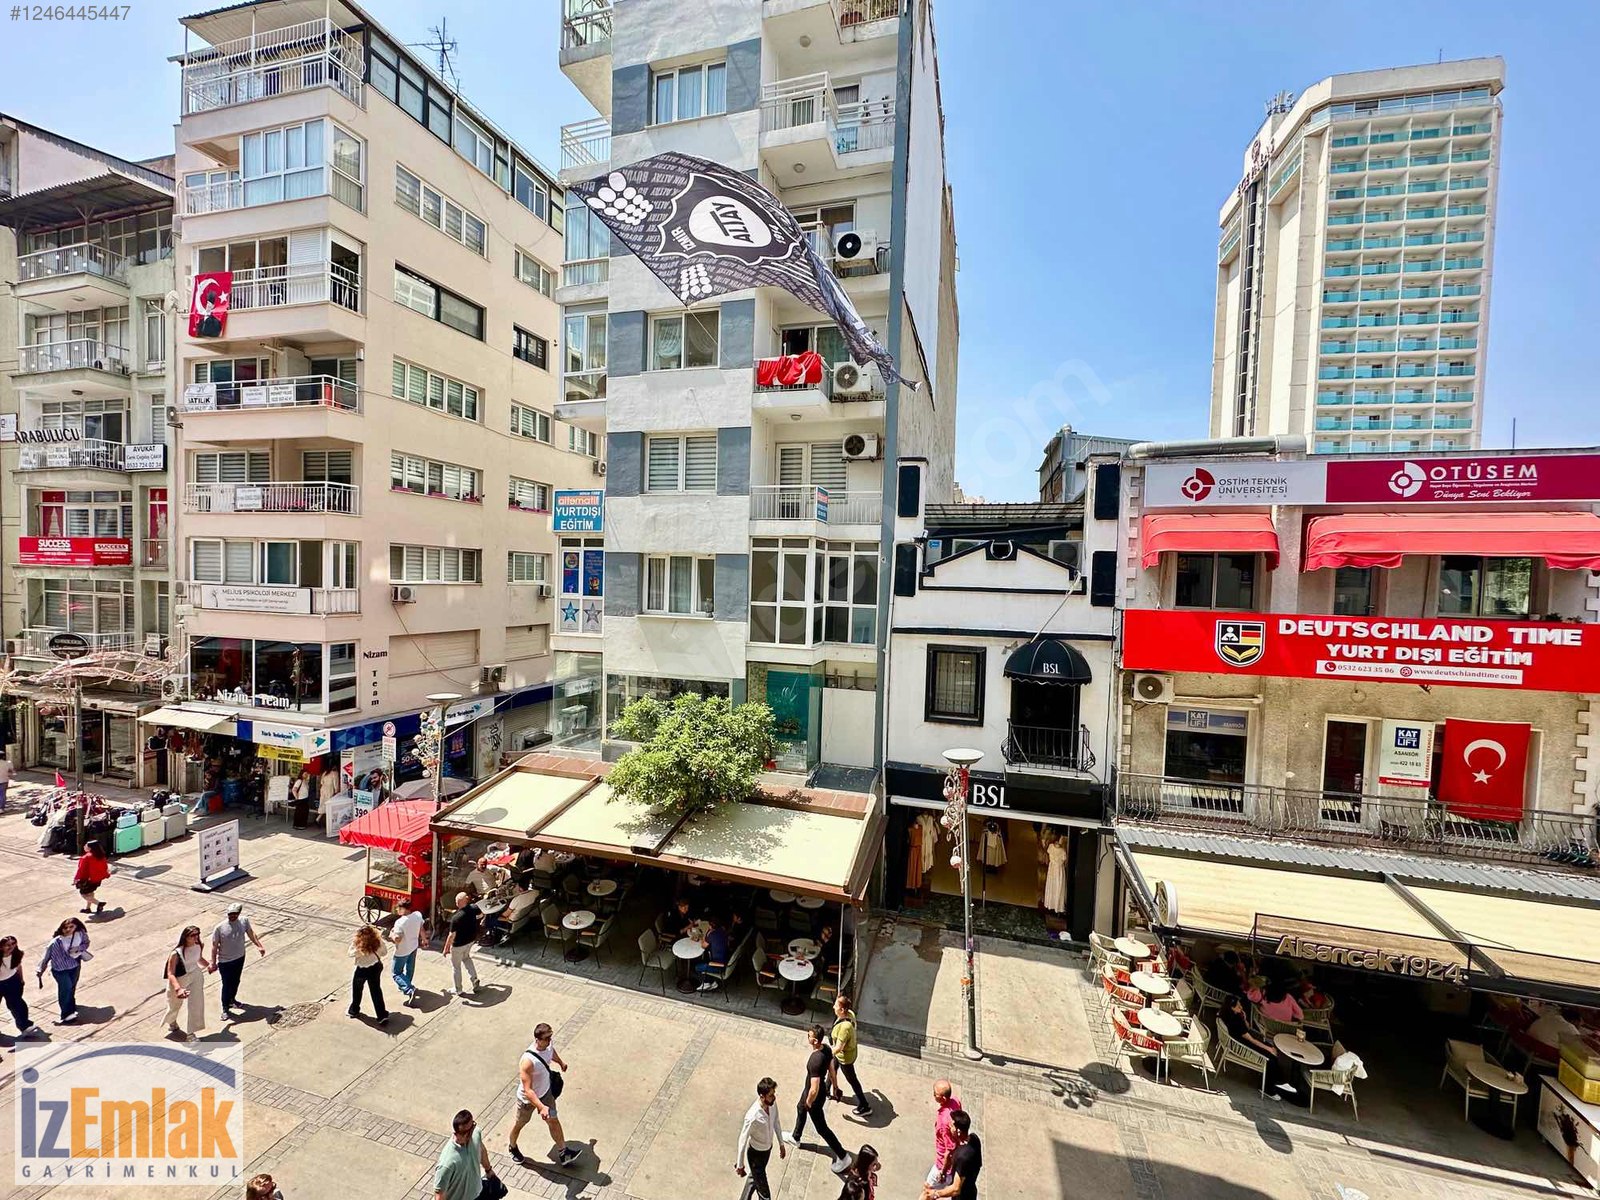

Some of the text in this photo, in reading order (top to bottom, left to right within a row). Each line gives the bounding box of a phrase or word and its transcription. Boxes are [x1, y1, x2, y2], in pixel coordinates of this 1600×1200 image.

[710, 202, 754, 244] ALTAY
[670, 226, 696, 252] İZMİR
[14, 428, 80, 444] ARABULUCU
[1430, 462, 1538, 480] OTÜSEM
[1219, 477, 1287, 485] OSTİM TEKNİK
[1218, 485, 1287, 494] ÜNİVERSİTESİ
[1434, 490, 1464, 499] Dünya
[556, 506, 600, 518] YURTDIŞI
[560, 518, 593, 530] EĞİTİM
[38, 540, 70, 548] SUCCESS
[1278, 619, 1582, 646] DEUTSCHLAND TIME
[1326, 644, 1532, 666] YURT DIŞI EĞİTİM
[1043, 663, 1061, 674] BSL
[217, 689, 290, 707] Nizam Team
[1398, 738, 1418, 746] LIFT
[973, 784, 1010, 808] BSL
[1276, 935, 1462, 986] Alsancak 1924
